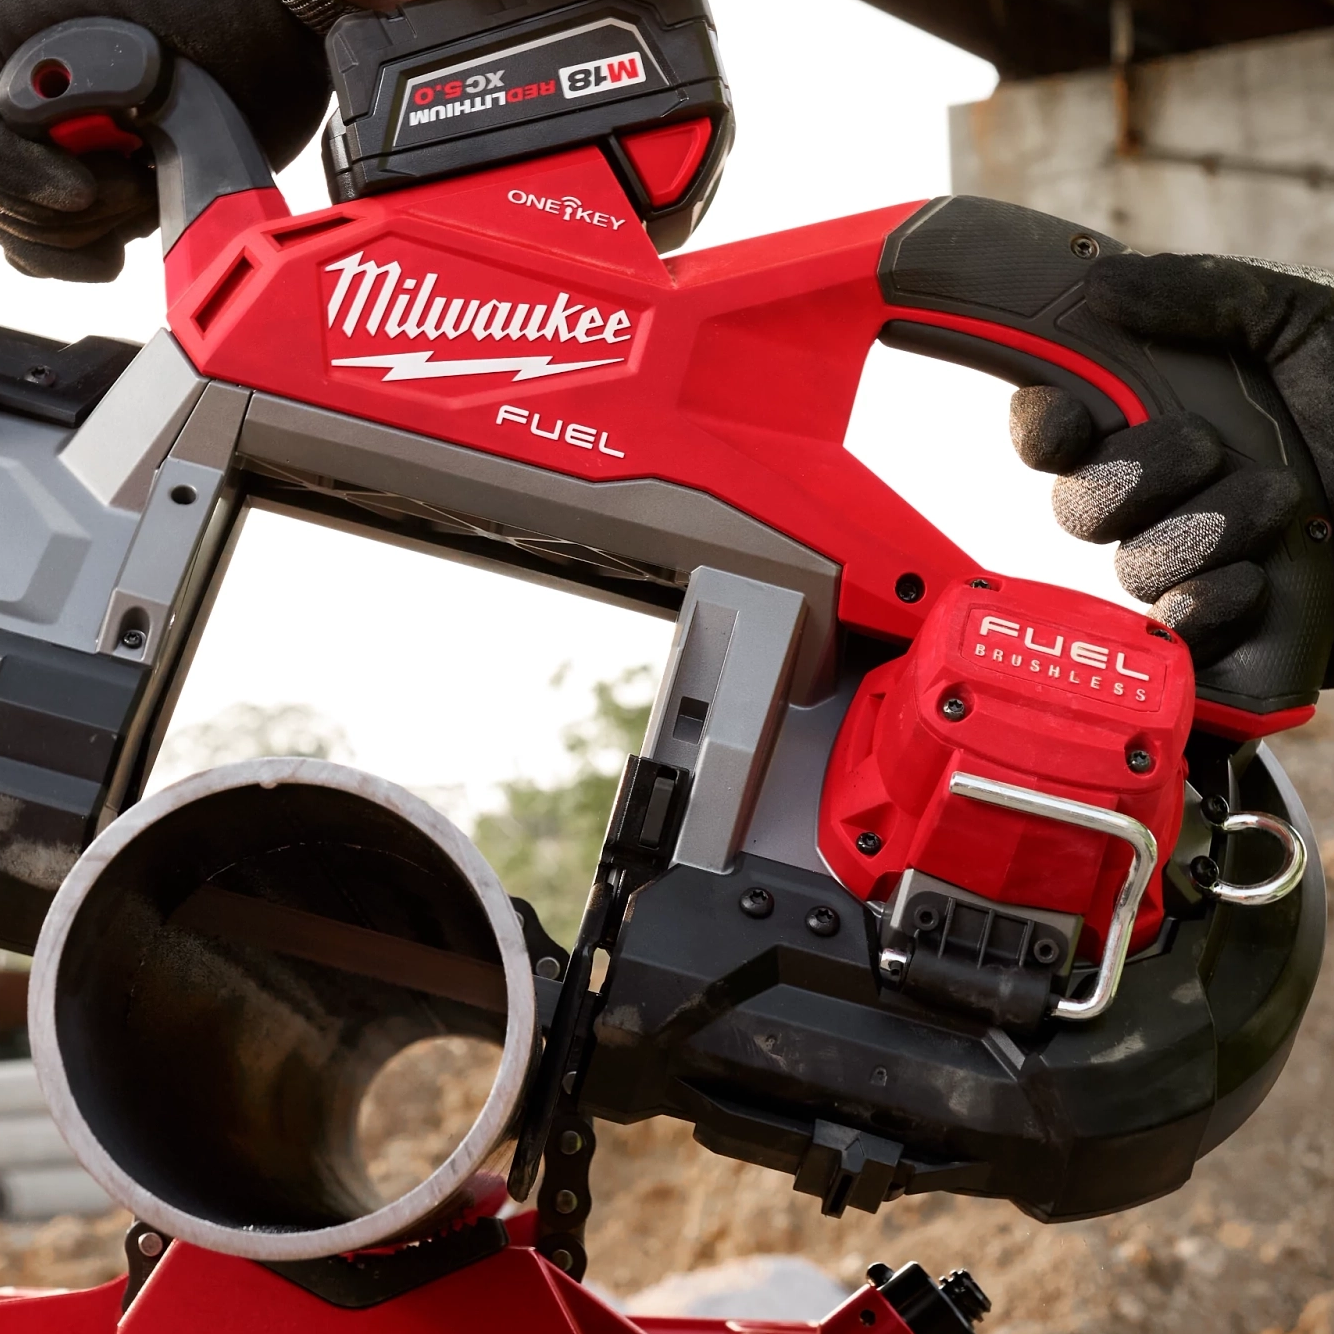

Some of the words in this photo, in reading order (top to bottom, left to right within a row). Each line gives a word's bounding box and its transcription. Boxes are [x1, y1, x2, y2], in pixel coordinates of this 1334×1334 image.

[567, 57, 640, 93] M18
[325, 251, 632, 345] Milwaukee
[495, 405, 626, 459] FUEL
[974, 643, 1146, 702] BRUSHLESS
[979, 615, 1150, 682] FUEL
